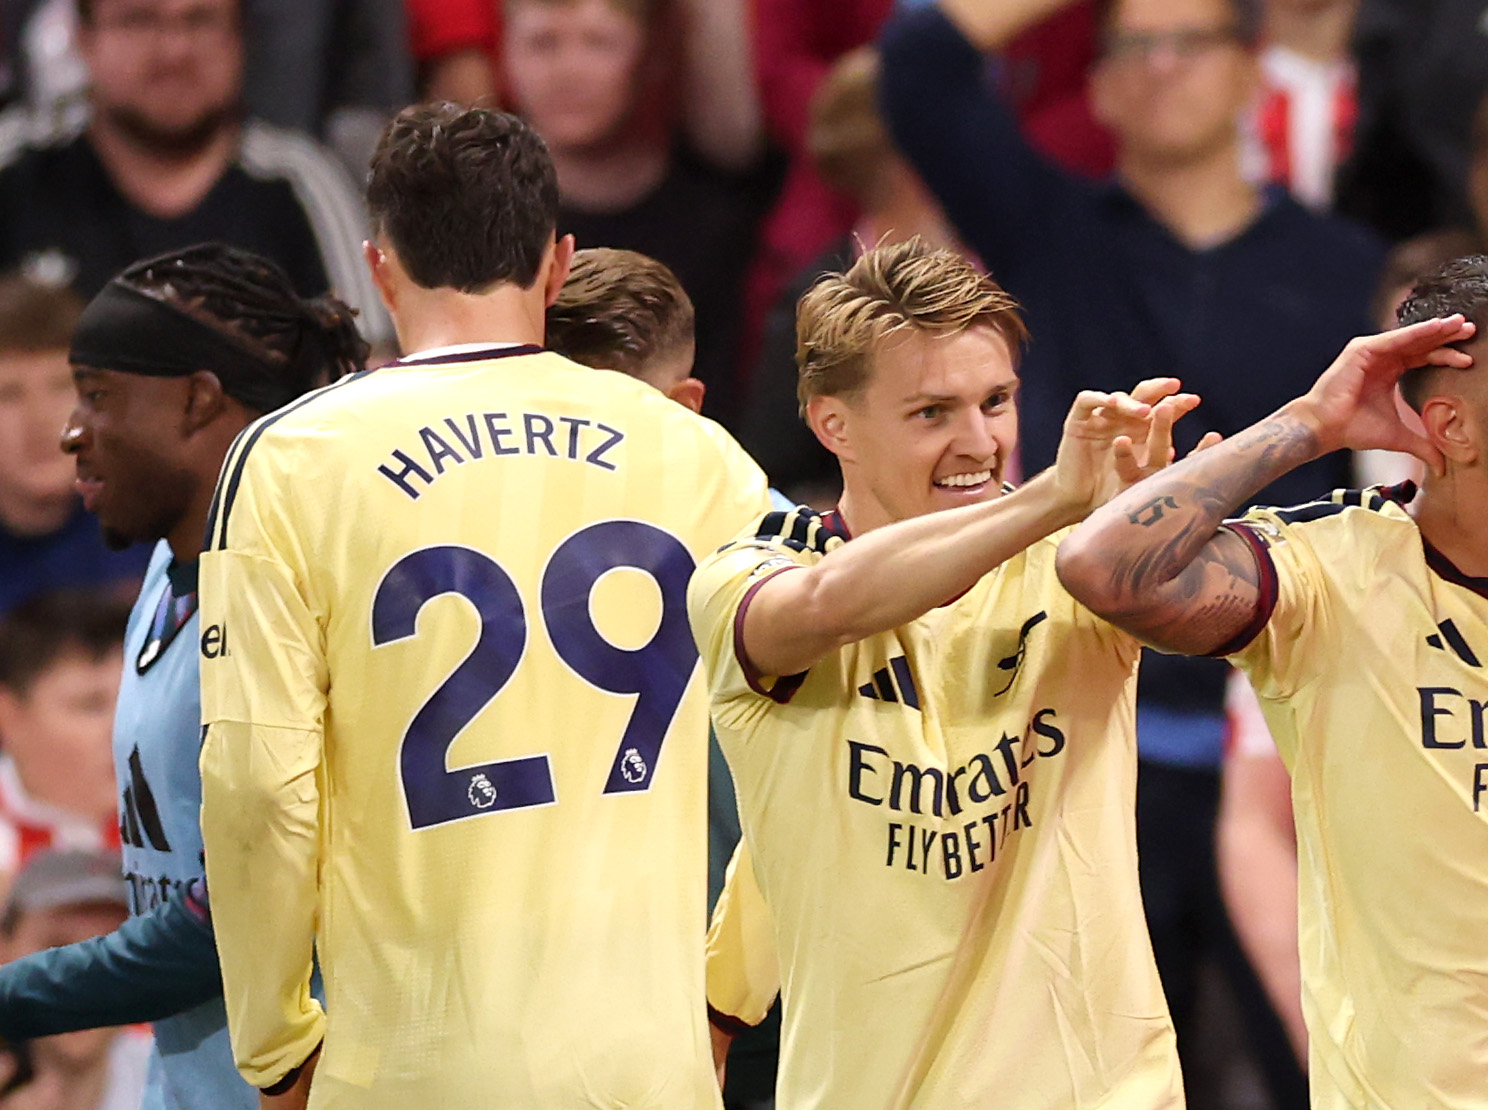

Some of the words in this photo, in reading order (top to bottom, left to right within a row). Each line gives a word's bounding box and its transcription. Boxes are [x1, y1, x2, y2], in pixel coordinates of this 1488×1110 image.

[376, 412, 626, 501] HAVERTZ
[368, 517, 703, 833] 29
[885, 822, 939, 876] FLY
